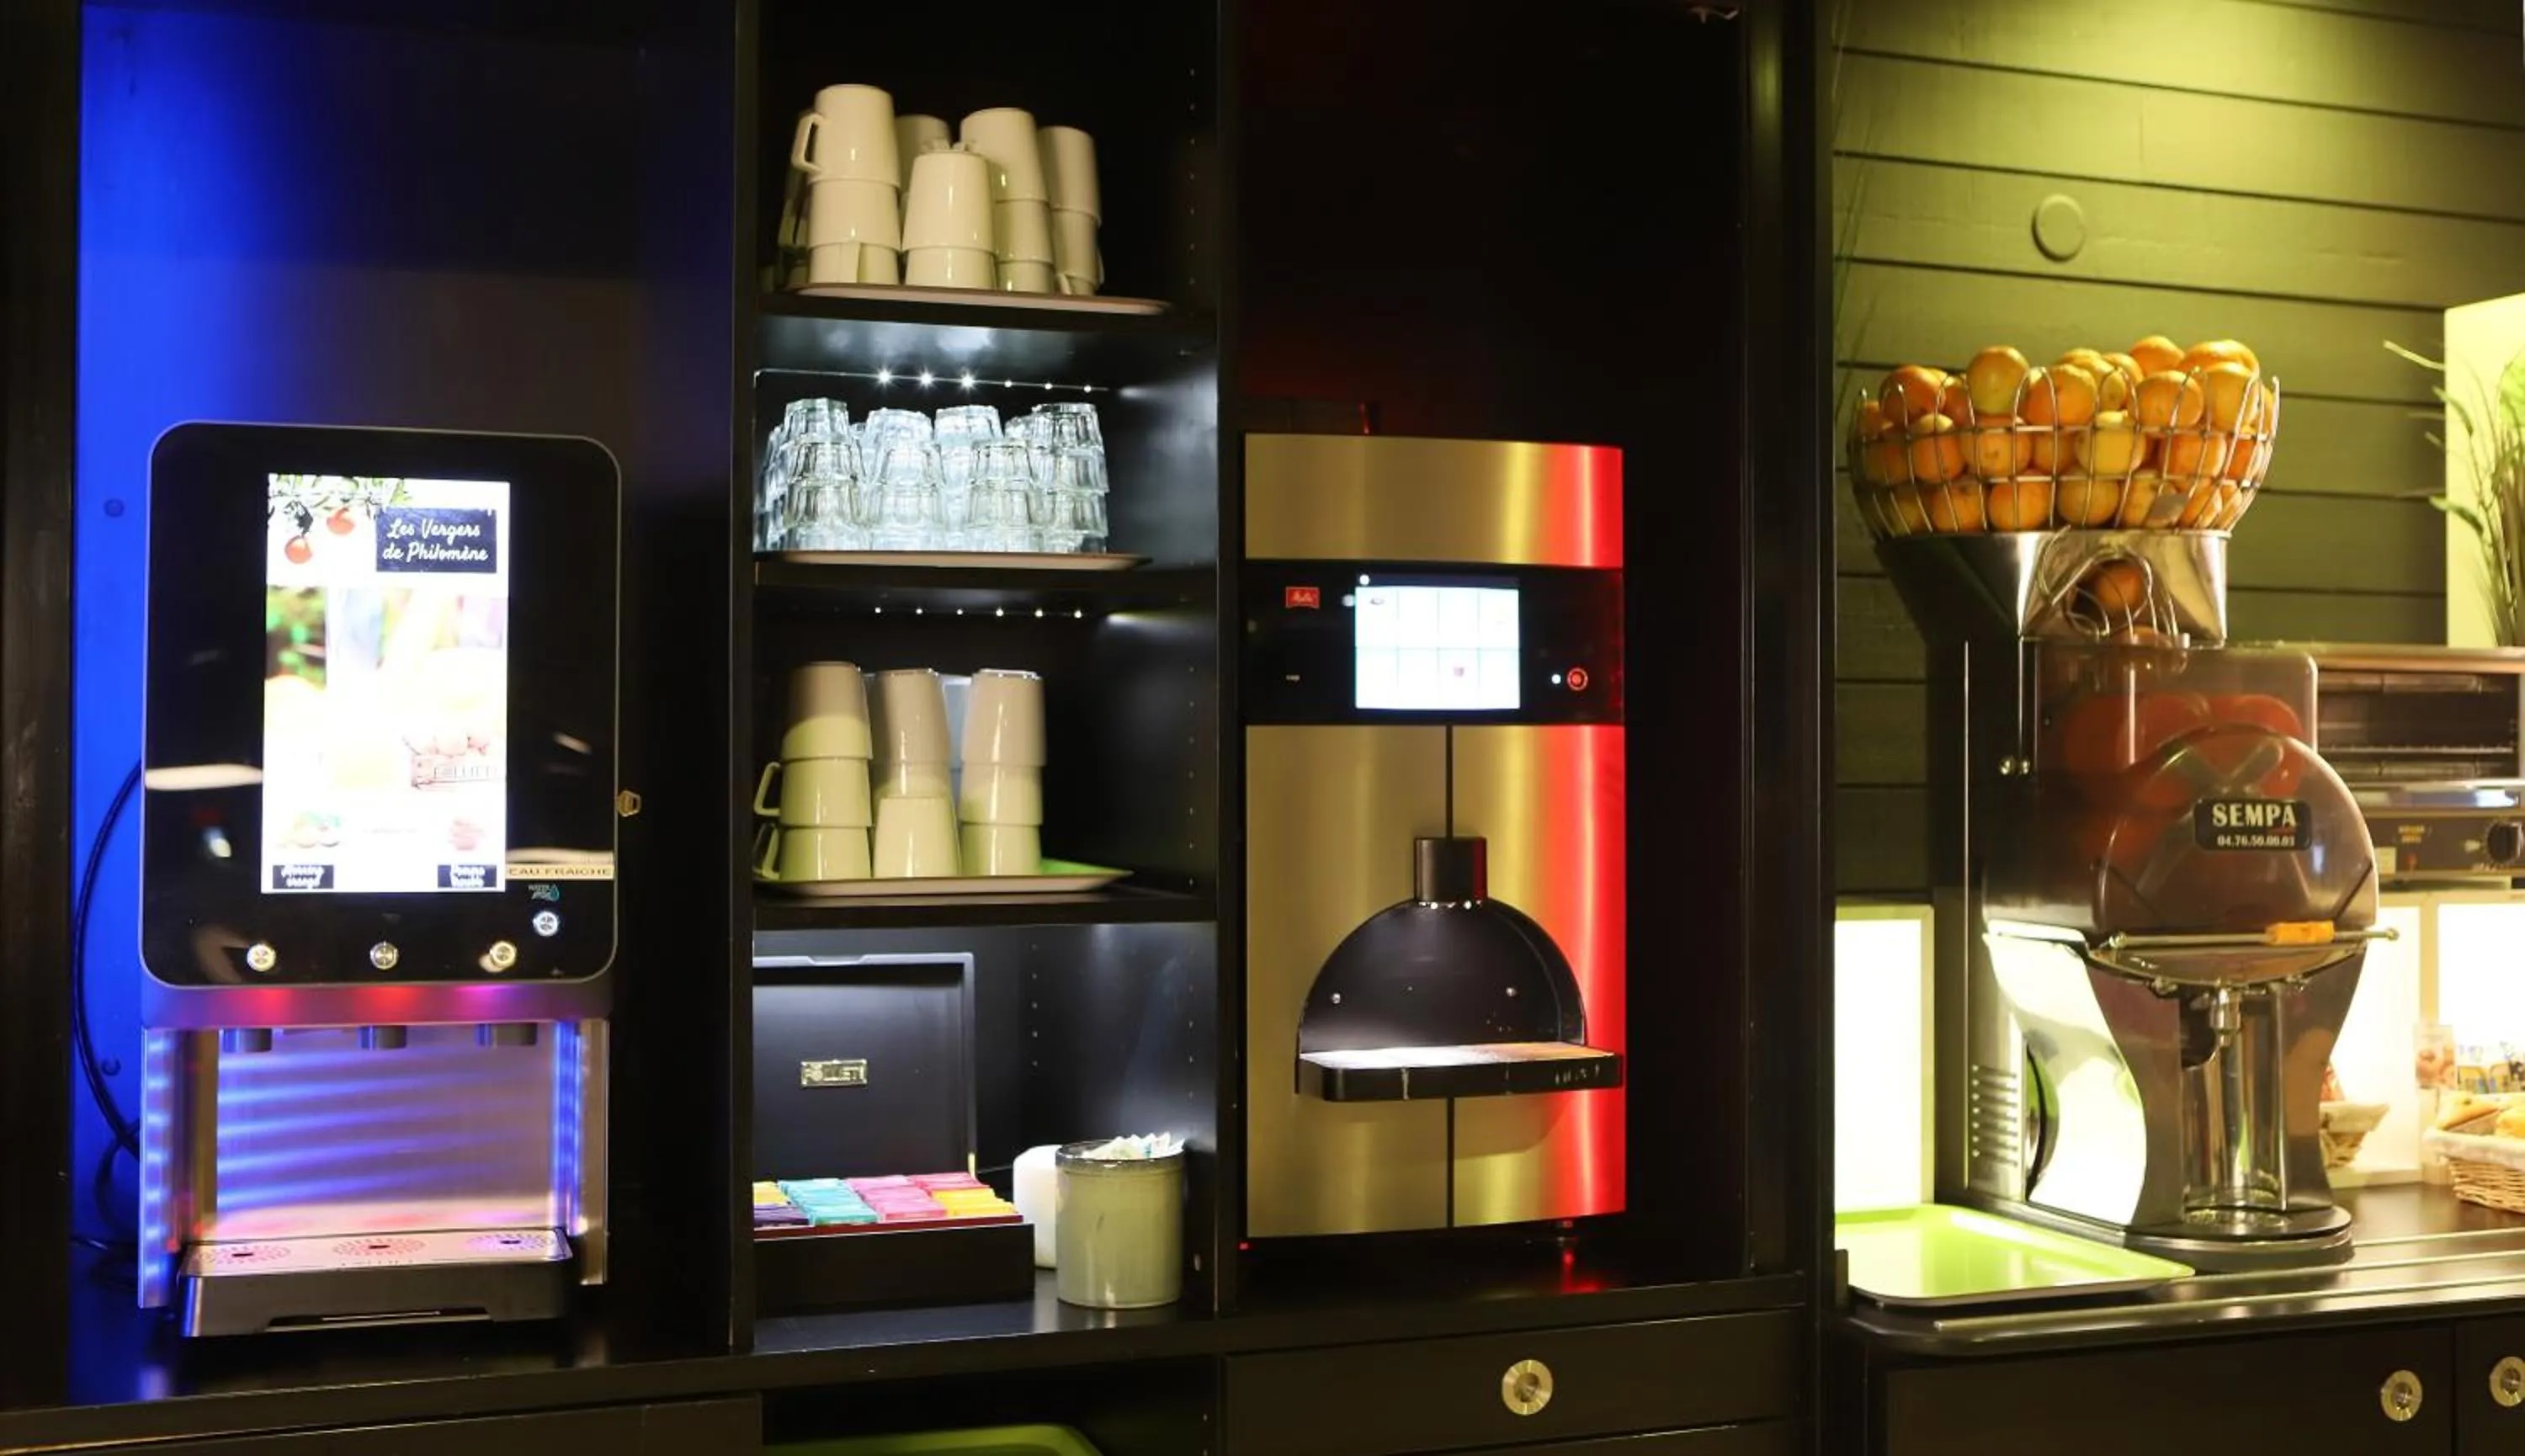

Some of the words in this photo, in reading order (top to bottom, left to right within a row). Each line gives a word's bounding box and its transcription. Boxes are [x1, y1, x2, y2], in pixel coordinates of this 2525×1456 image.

[386, 518, 415, 539] Les
[422, 518, 481, 545] Vergers
[382, 542, 404, 560] de
[407, 540, 488, 562] Philomène
[2212, 803, 2297, 827] SEMPA
[509, 868, 540, 876] EAU
[545, 868, 612, 876] FRAICHE
